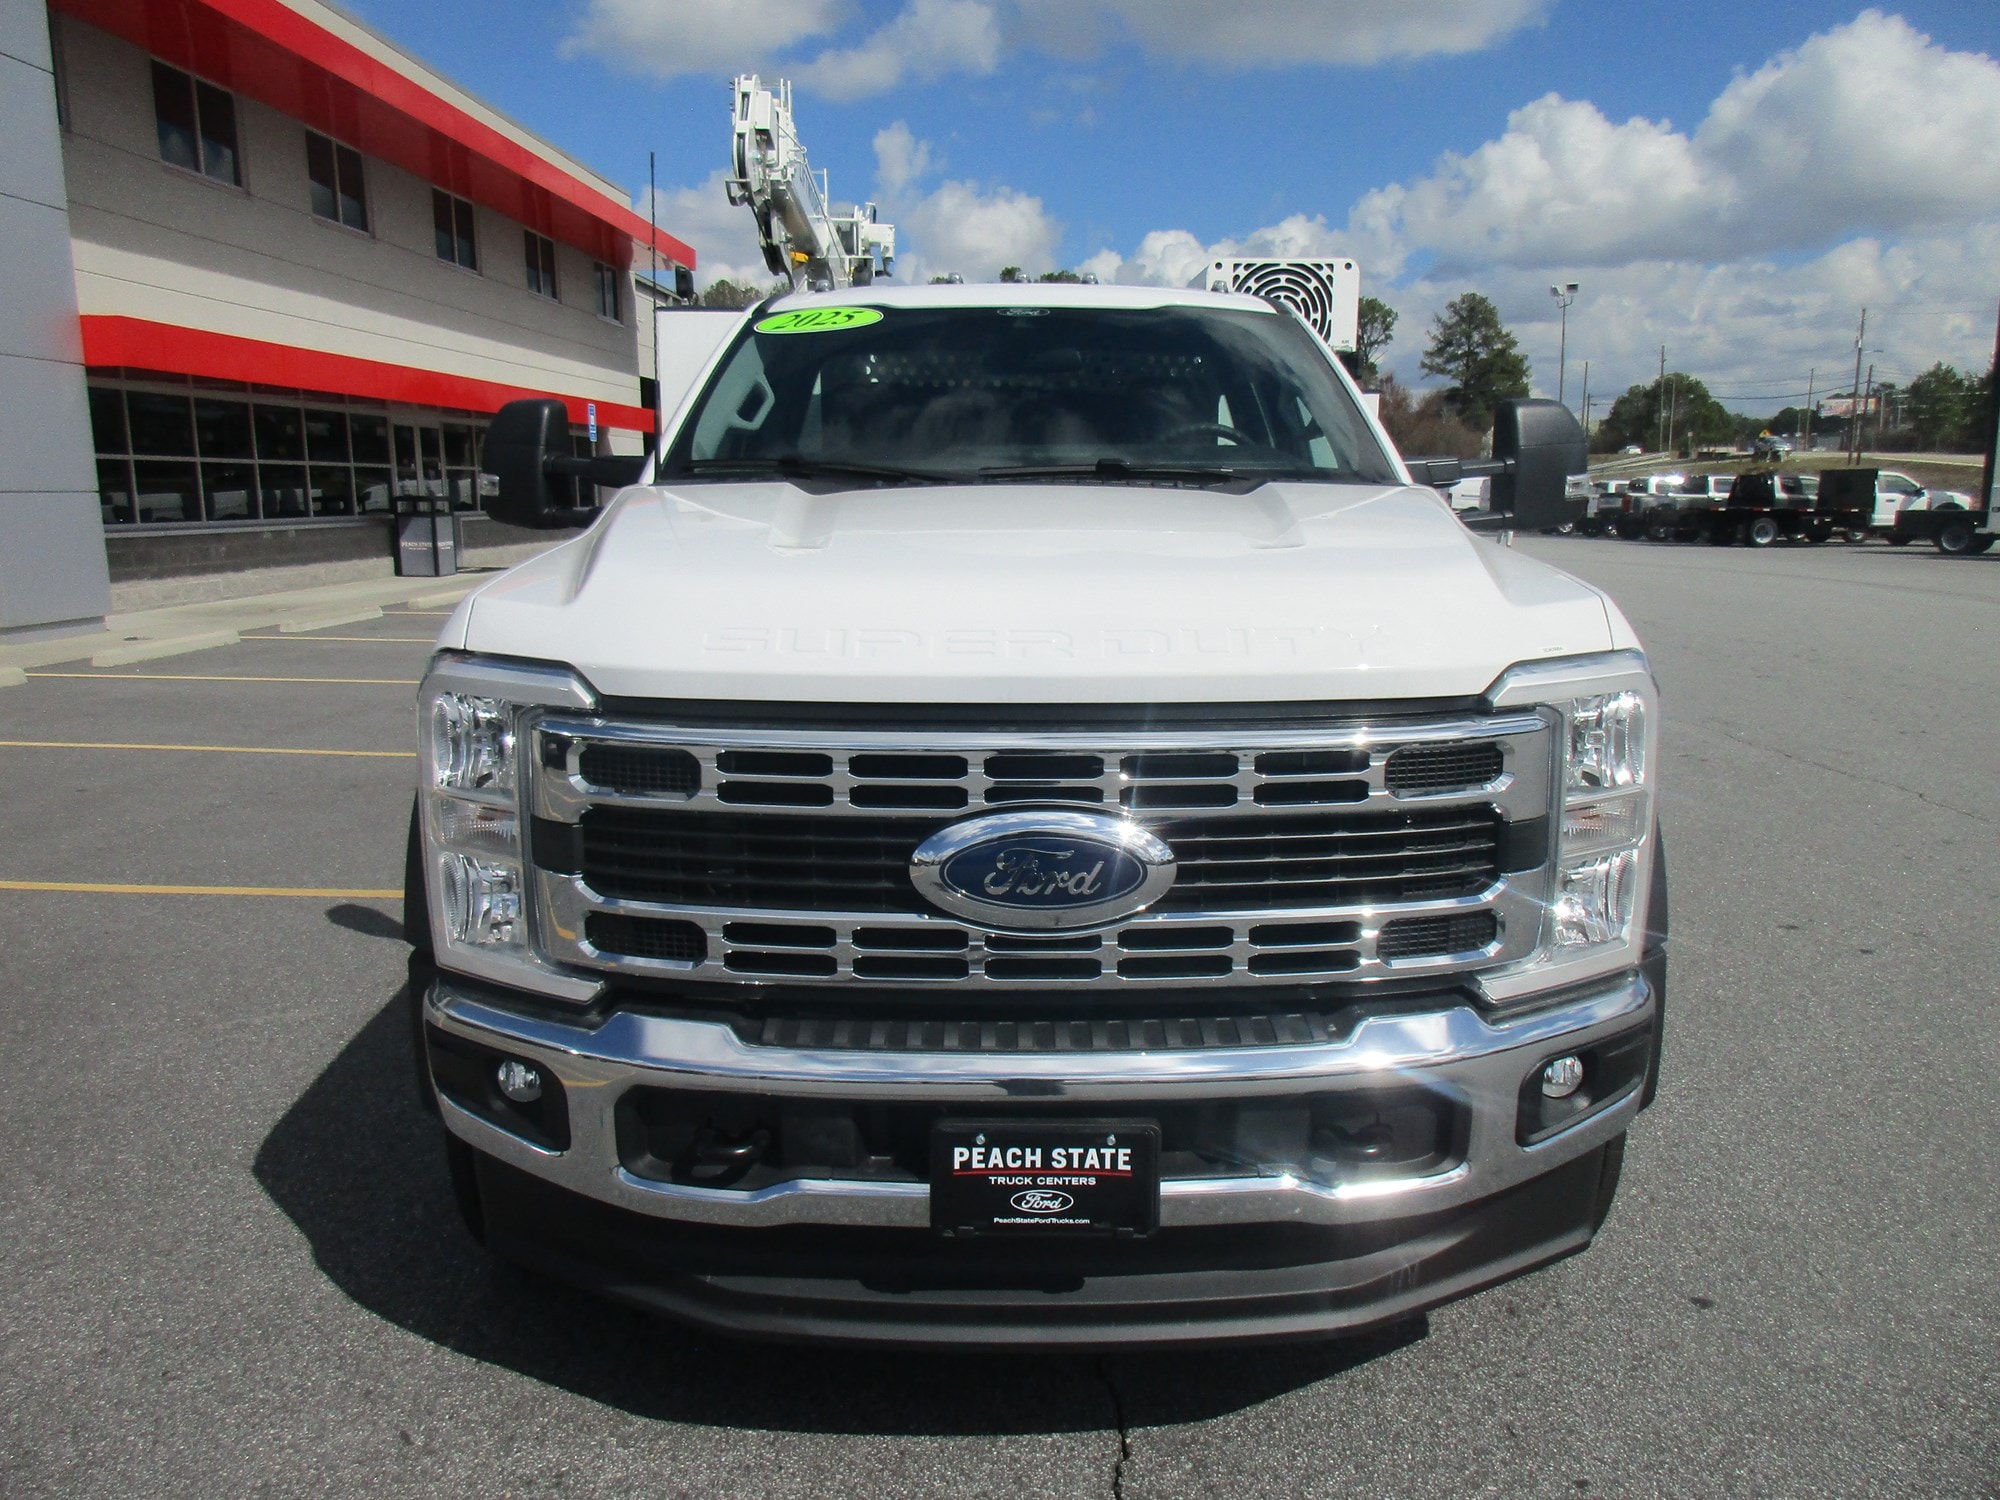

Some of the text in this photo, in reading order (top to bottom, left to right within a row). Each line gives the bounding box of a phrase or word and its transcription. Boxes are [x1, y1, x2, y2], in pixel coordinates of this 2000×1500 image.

[772, 310, 864, 330] 2025
[703, 624, 1383, 658] SUPER DUTY
[983, 847, 1105, 896] Ford
[953, 1147, 1132, 1171] PEACH STATE
[989, 1176, 1097, 1186] TRUCK CENTERS
[1021, 1192, 1062, 1210] Ford
[993, 1217, 1090, 1225] PeachStateFordTrucks.com
